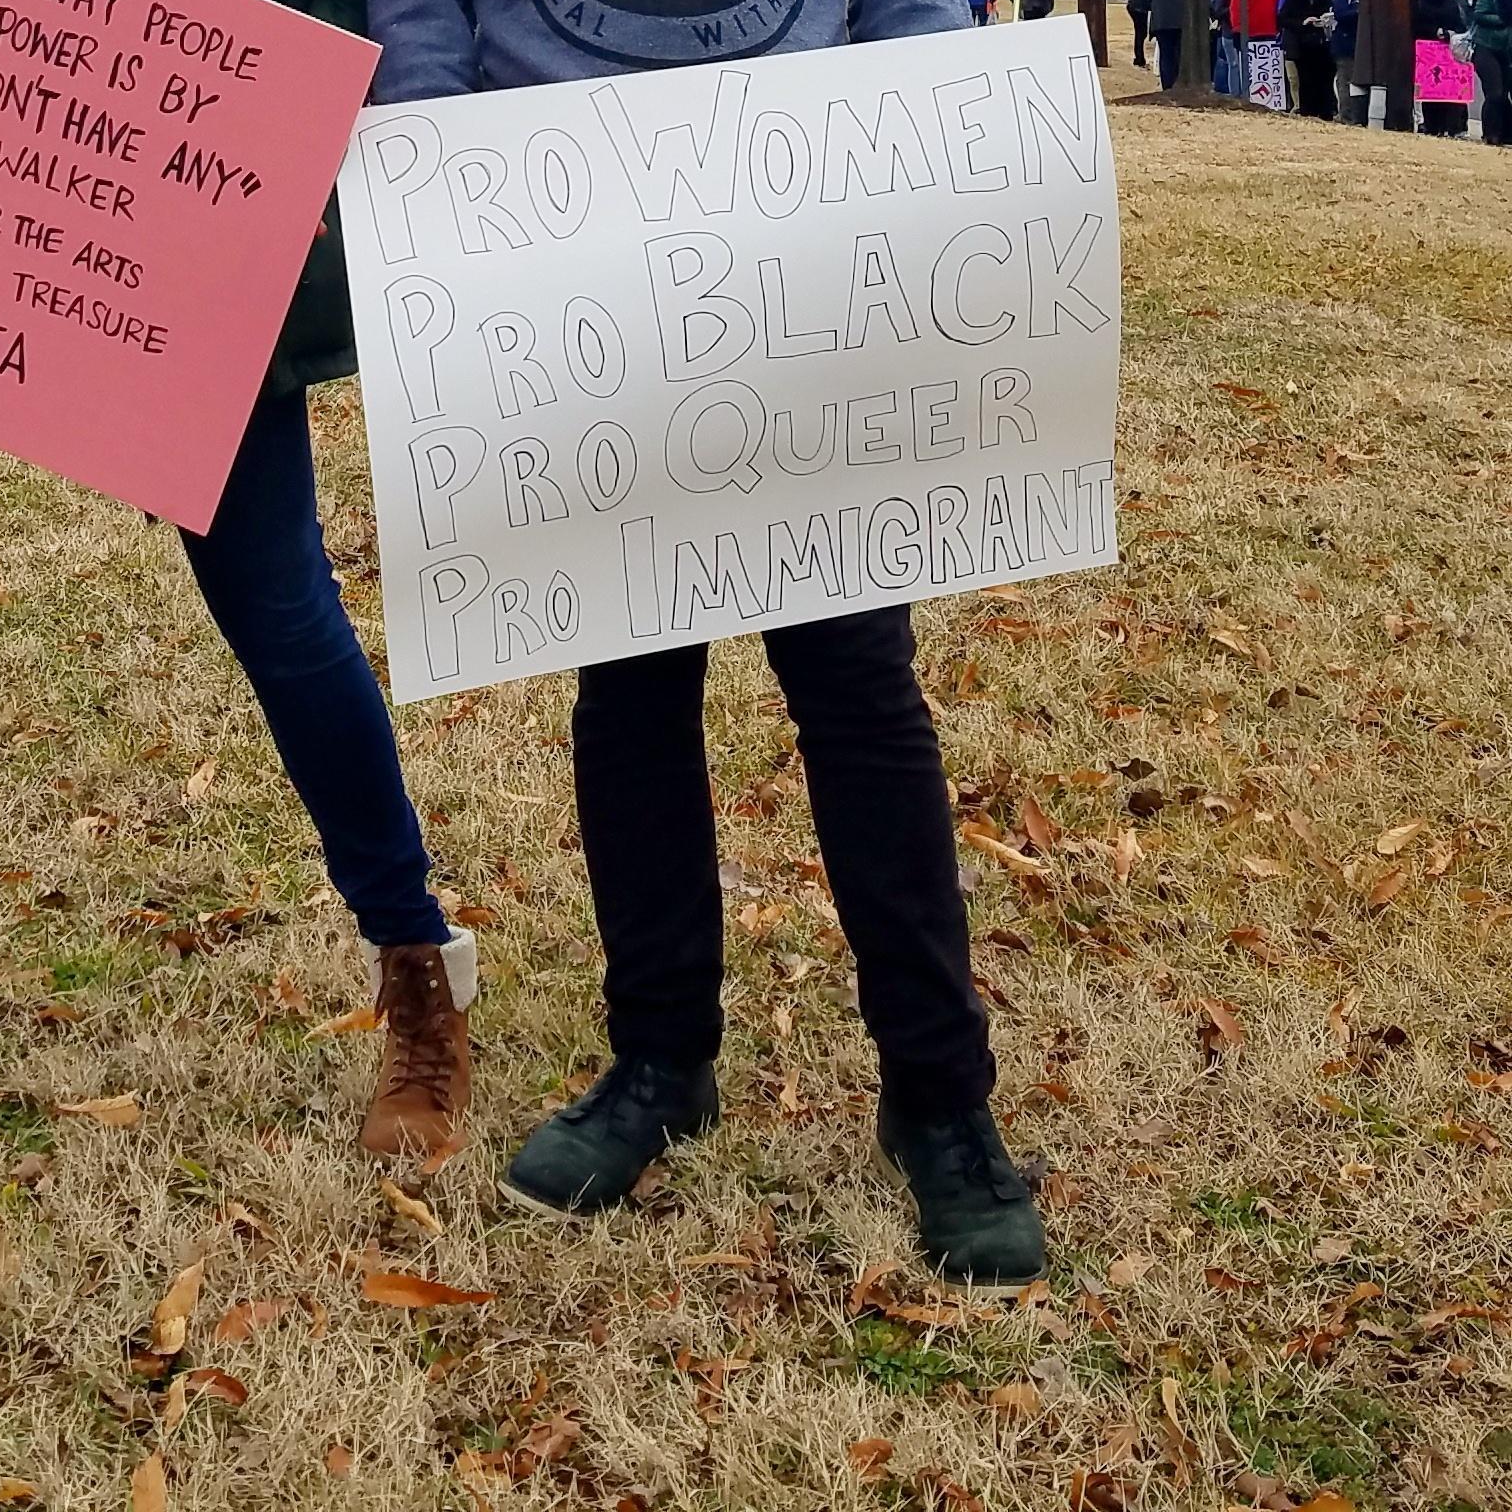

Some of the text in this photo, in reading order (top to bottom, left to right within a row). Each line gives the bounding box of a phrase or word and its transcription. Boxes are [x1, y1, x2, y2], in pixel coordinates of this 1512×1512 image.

[108, 52, 143, 91] IS
[159, 74, 220, 123] BY
[144, 3, 262, 81] PEOPLE
[63, 101, 146, 162] HAVE
[161, 141, 262, 206] ANY"
[358, 55, 1097, 264] PRO WOMEN
[14, 215, 64, 254] THE
[72, 241, 143, 289] ARTS
[13, 272, 168, 354] TREASURE
[385, 214, 1110, 423] PRO BLACK
[409, 367, 1038, 550] PRO QUEER
[419, 460, 1113, 681] PRO IMMIGRANT
